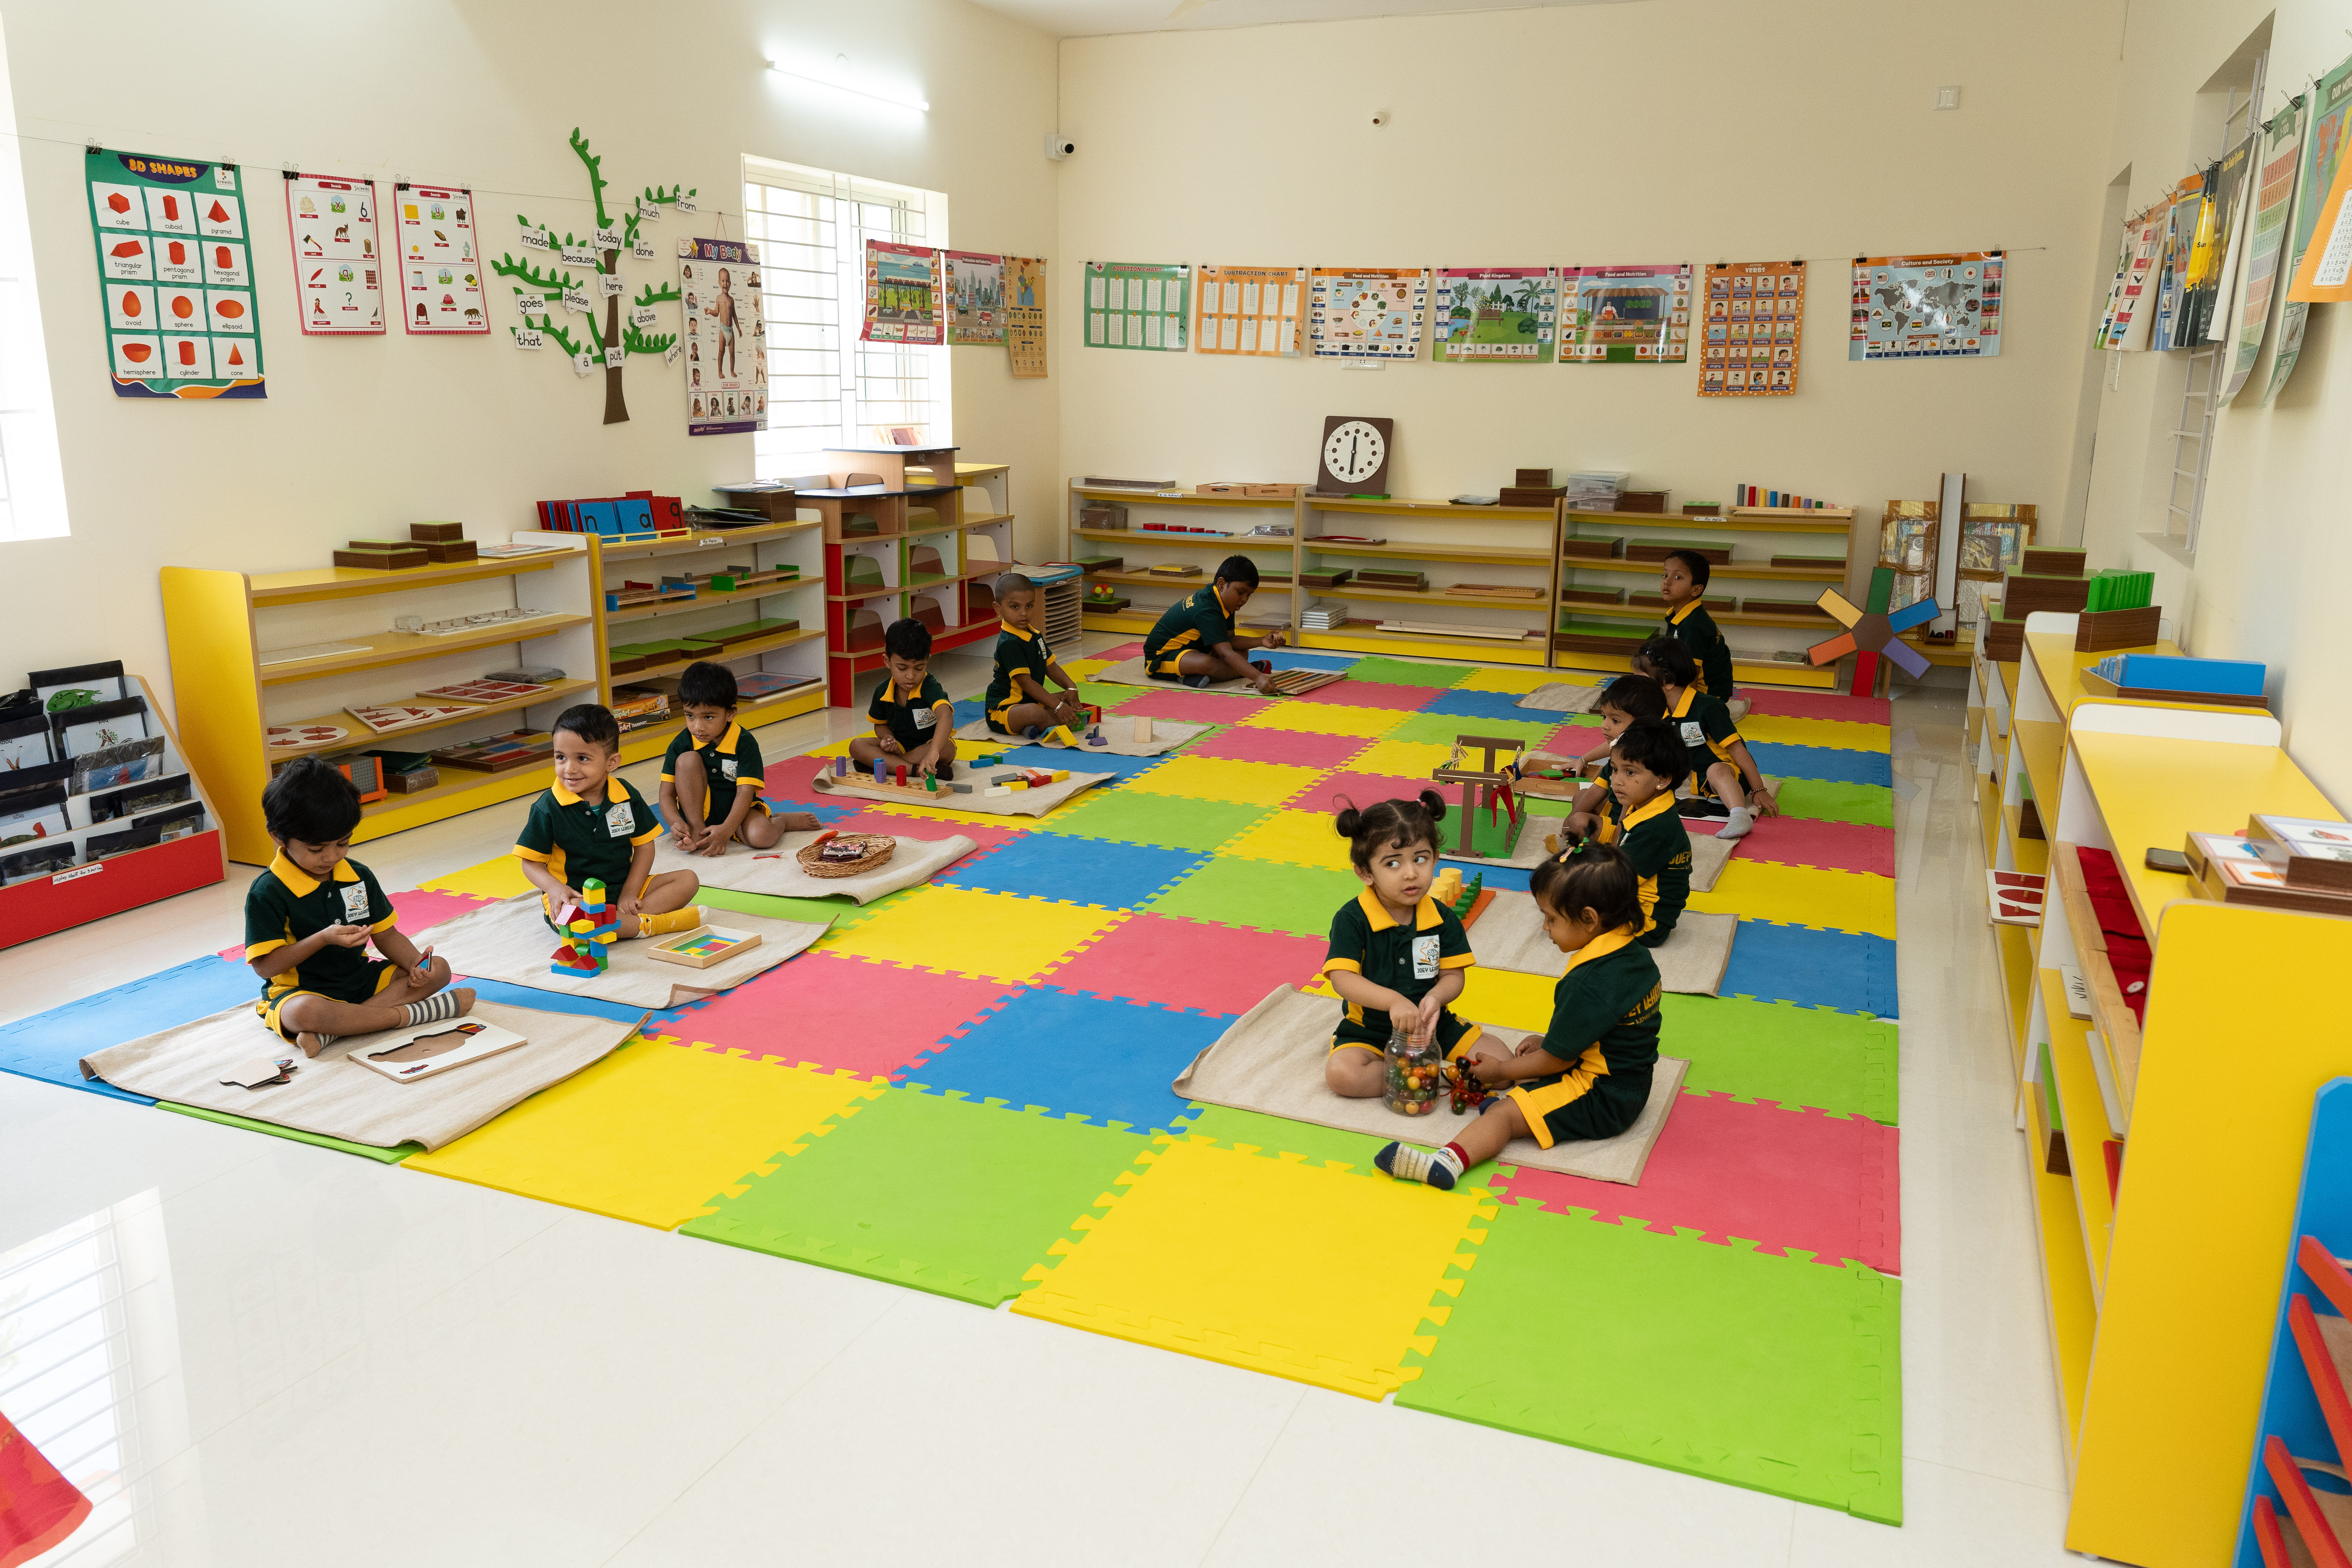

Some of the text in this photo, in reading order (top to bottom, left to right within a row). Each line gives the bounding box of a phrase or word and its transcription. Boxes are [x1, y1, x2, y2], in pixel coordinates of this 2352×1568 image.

[129, 159, 197, 178] 3D SHAPES
[361, 202, 367, 218] 6
[677, 197, 696, 211] from
[436, 207, 440, 217] y
[640, 206, 660, 219] much
[522, 235, 549, 247] made
[597, 230, 622, 250] today
[561, 248, 595, 264] because
[636, 248, 654, 257] done
[704, 244, 718, 260] My
[720, 245, 742, 262] Body
[343, 270, 350, 280] q
[443, 269, 447, 281] j
[606, 281, 623, 291] here
[564, 289, 589, 306] please
[520, 299, 543, 314] goes
[637, 313, 656, 323] above
[517, 334, 542, 347] that
[610, 352, 622, 366] put
[668, 346, 682, 364] where
[584, 513, 598, 531] n
[639, 512, 652, 528] a
[670, 502, 682, 529] g
